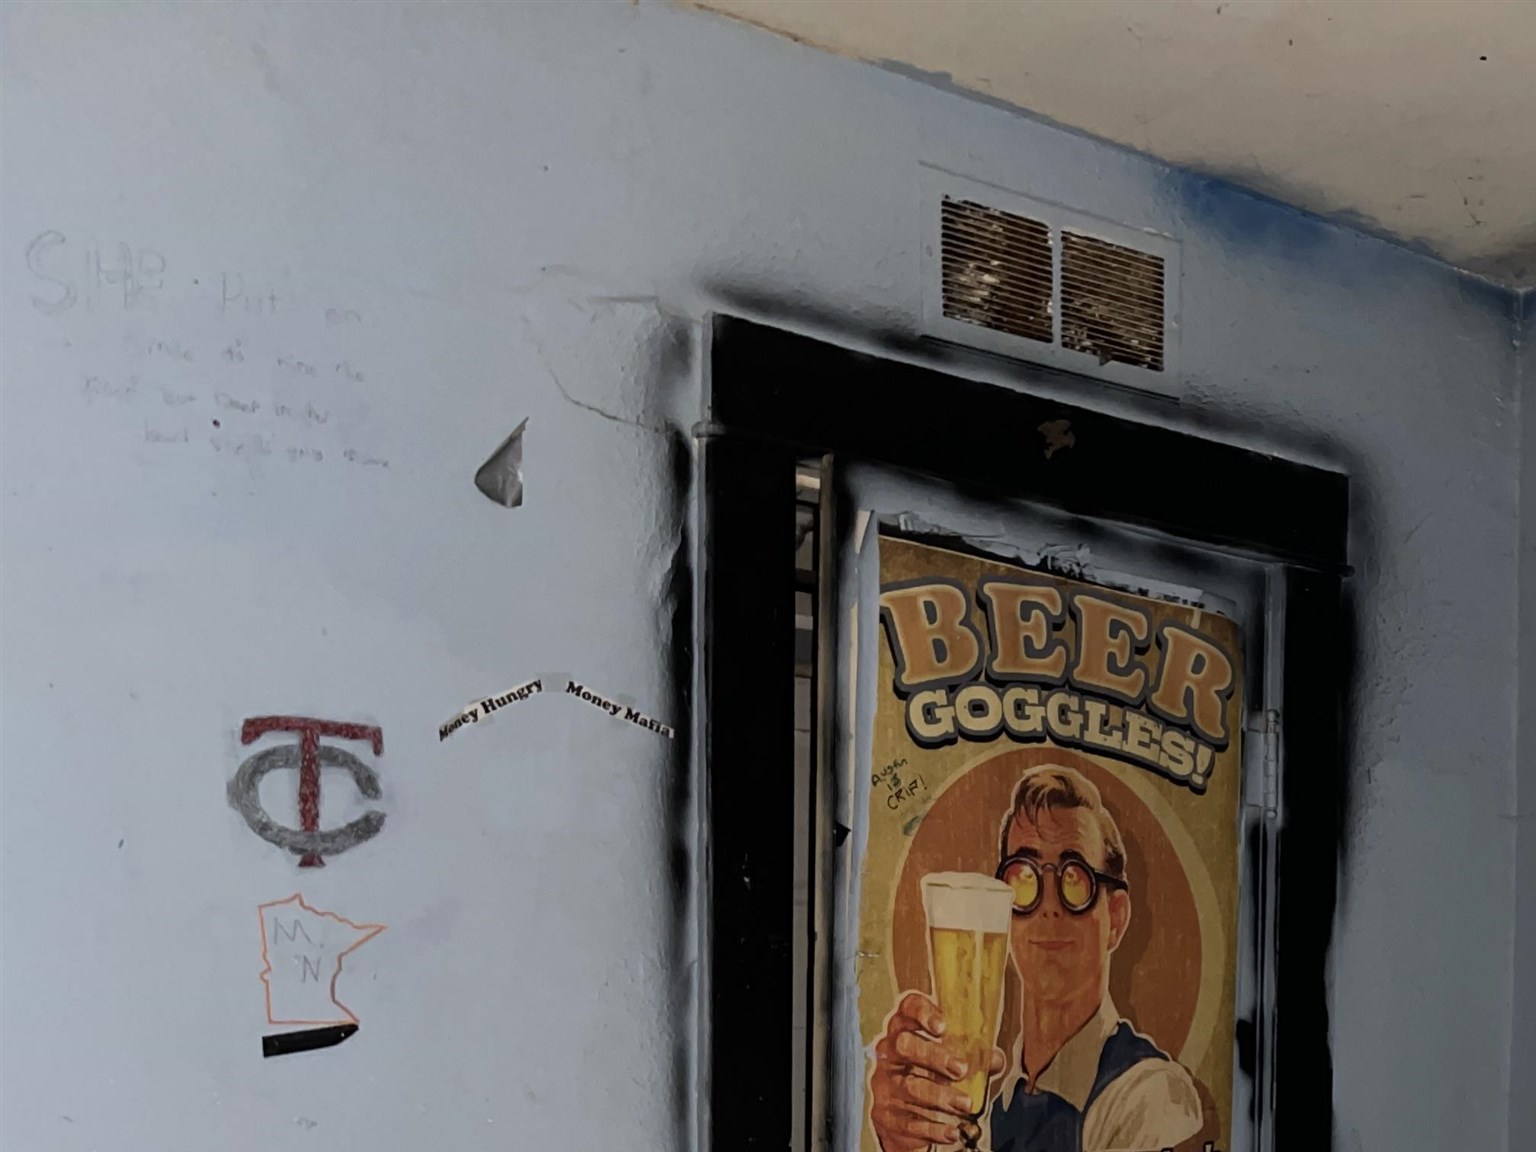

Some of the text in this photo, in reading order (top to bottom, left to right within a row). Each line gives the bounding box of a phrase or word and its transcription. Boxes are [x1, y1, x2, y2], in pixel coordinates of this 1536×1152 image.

[438, 679, 672, 742] Money Hungry Money Mafia
[877, 580, 1234, 742] BEER
[907, 686, 1218, 790] GOGGLES!
